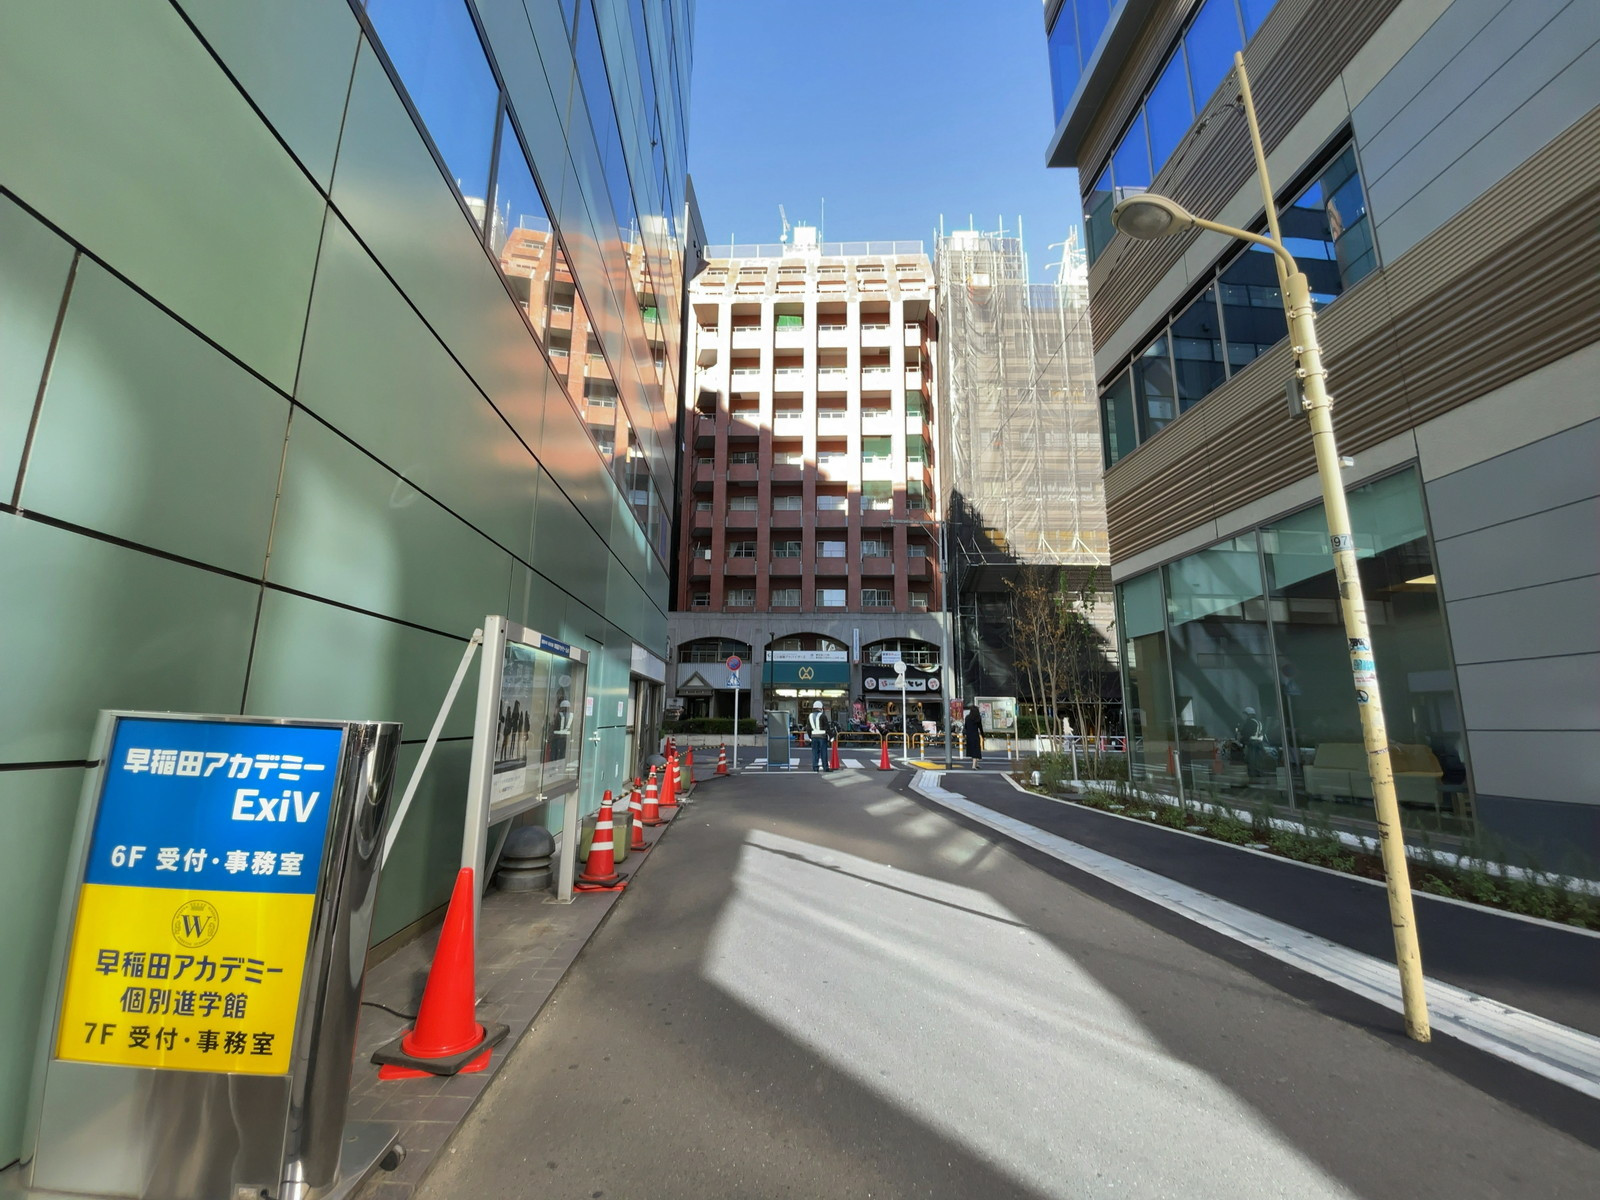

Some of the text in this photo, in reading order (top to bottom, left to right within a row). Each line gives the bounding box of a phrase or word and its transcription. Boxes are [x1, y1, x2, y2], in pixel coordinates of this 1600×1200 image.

[123, 748, 325, 781] 早稲田アカデミー
[231, 788, 320, 823] ExiV
[111, 845, 304, 876] 6F 受付・事務室
[181, 914, 213, 939] W
[95, 948, 284, 984] 早稲田アカデミー
[120, 986, 248, 1019] 個別進学館
[84, 1022, 275, 1056] 7F 受付・事務室
